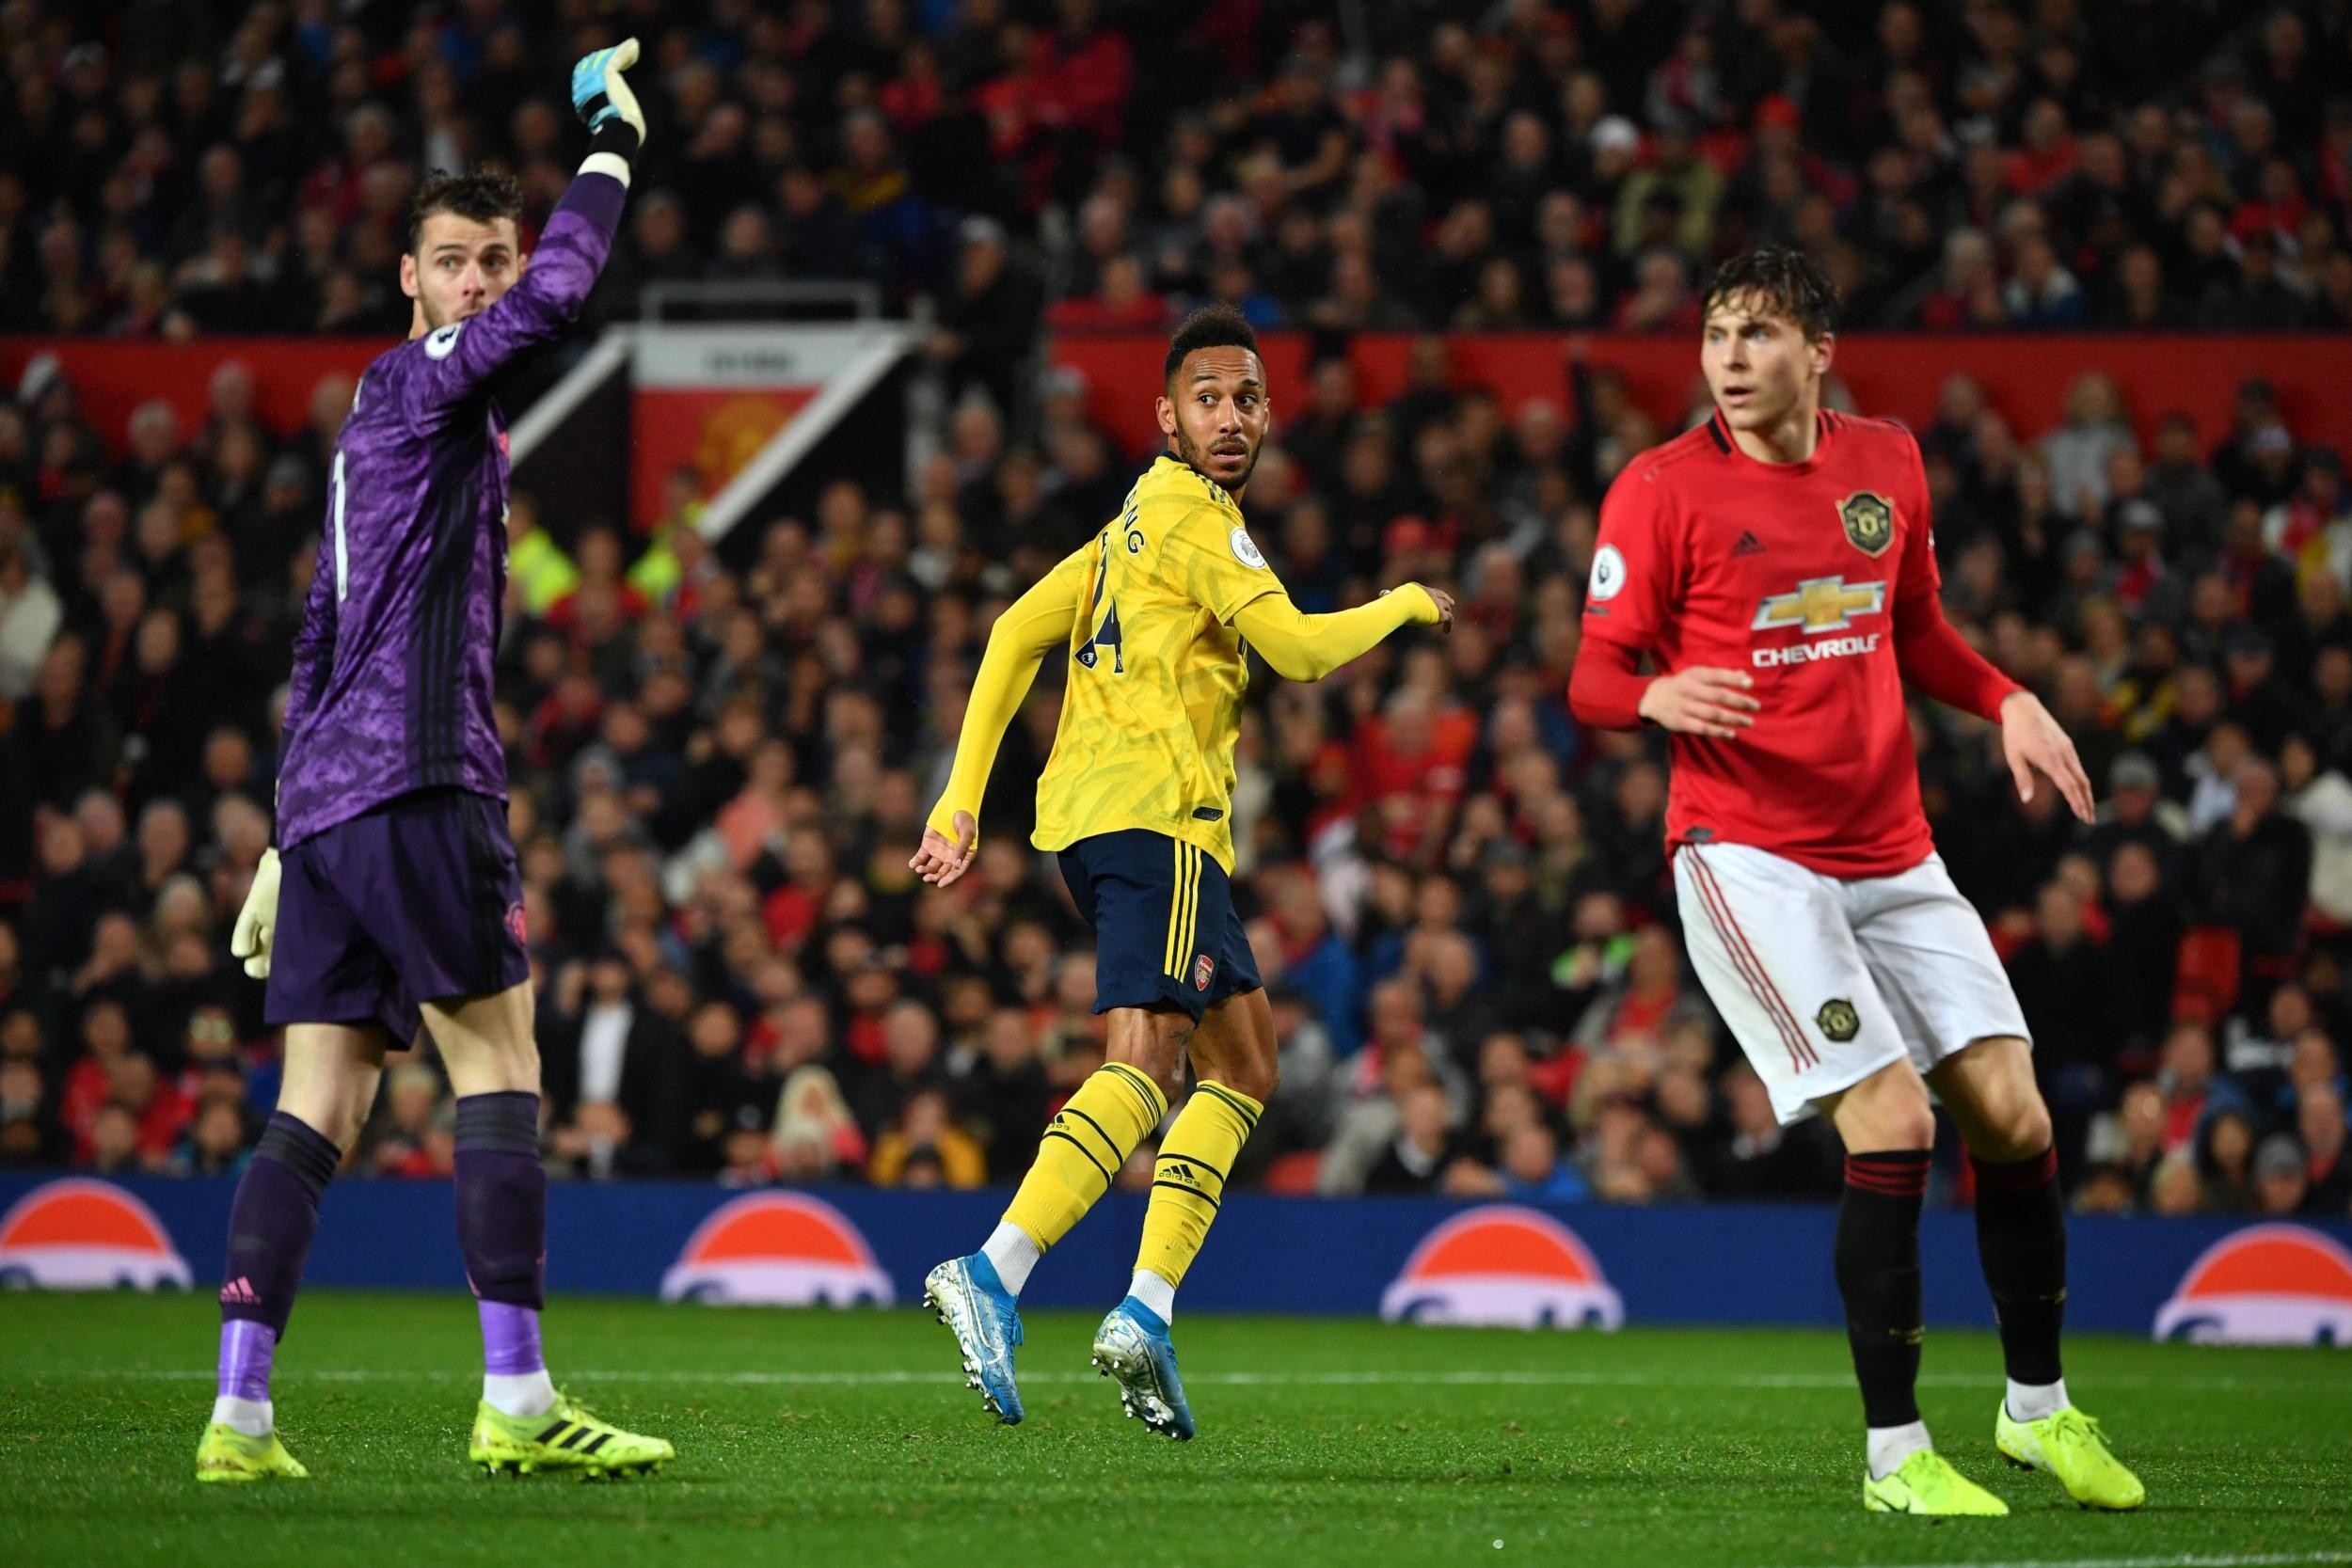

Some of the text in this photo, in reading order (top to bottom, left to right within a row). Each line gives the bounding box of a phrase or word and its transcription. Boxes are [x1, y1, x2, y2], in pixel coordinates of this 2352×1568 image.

[332, 449, 348, 603] 1
[1752, 632, 1881, 668] CHEVROLE
[1158, 1172, 1201, 1188] adidas
